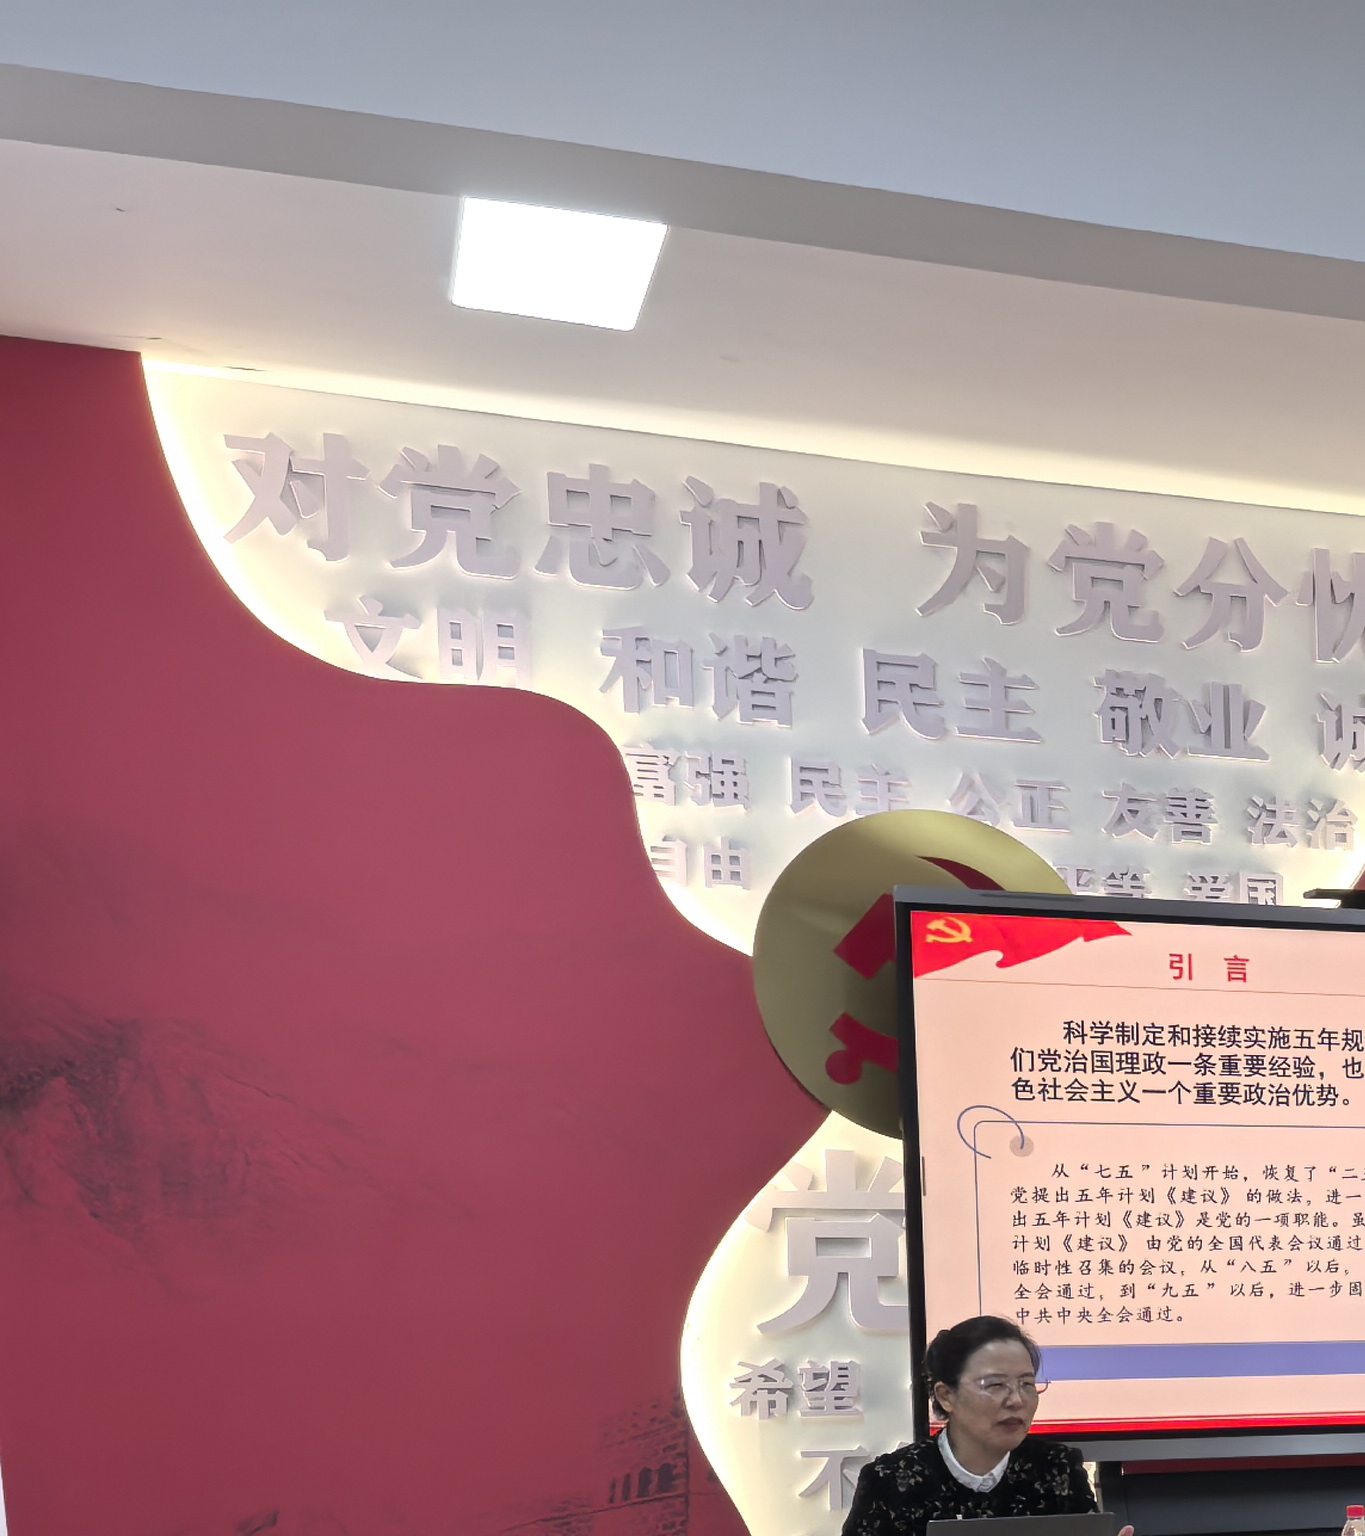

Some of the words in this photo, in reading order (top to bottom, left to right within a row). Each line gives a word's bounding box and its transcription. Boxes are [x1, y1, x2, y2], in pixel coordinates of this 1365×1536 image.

[222, 430, 815, 612] 对党忠诚
[323, 594, 532, 690] 文明
[598, 624, 798, 728] 和谐
[860, 646, 1043, 745] 民主
[1093, 668, 1270, 763] 敬业
[622, 742, 750, 814] 富强
[788, 754, 913, 818] 民主
[946, 770, 1072, 834] 公正
[1100, 782, 1221, 846] 友善
[1246, 794, 1360, 852] 法治
[1010, 1076, 1355, 1108] 色社会主义一个重要政治优势。
[730, 1360, 863, 1420] 希望
